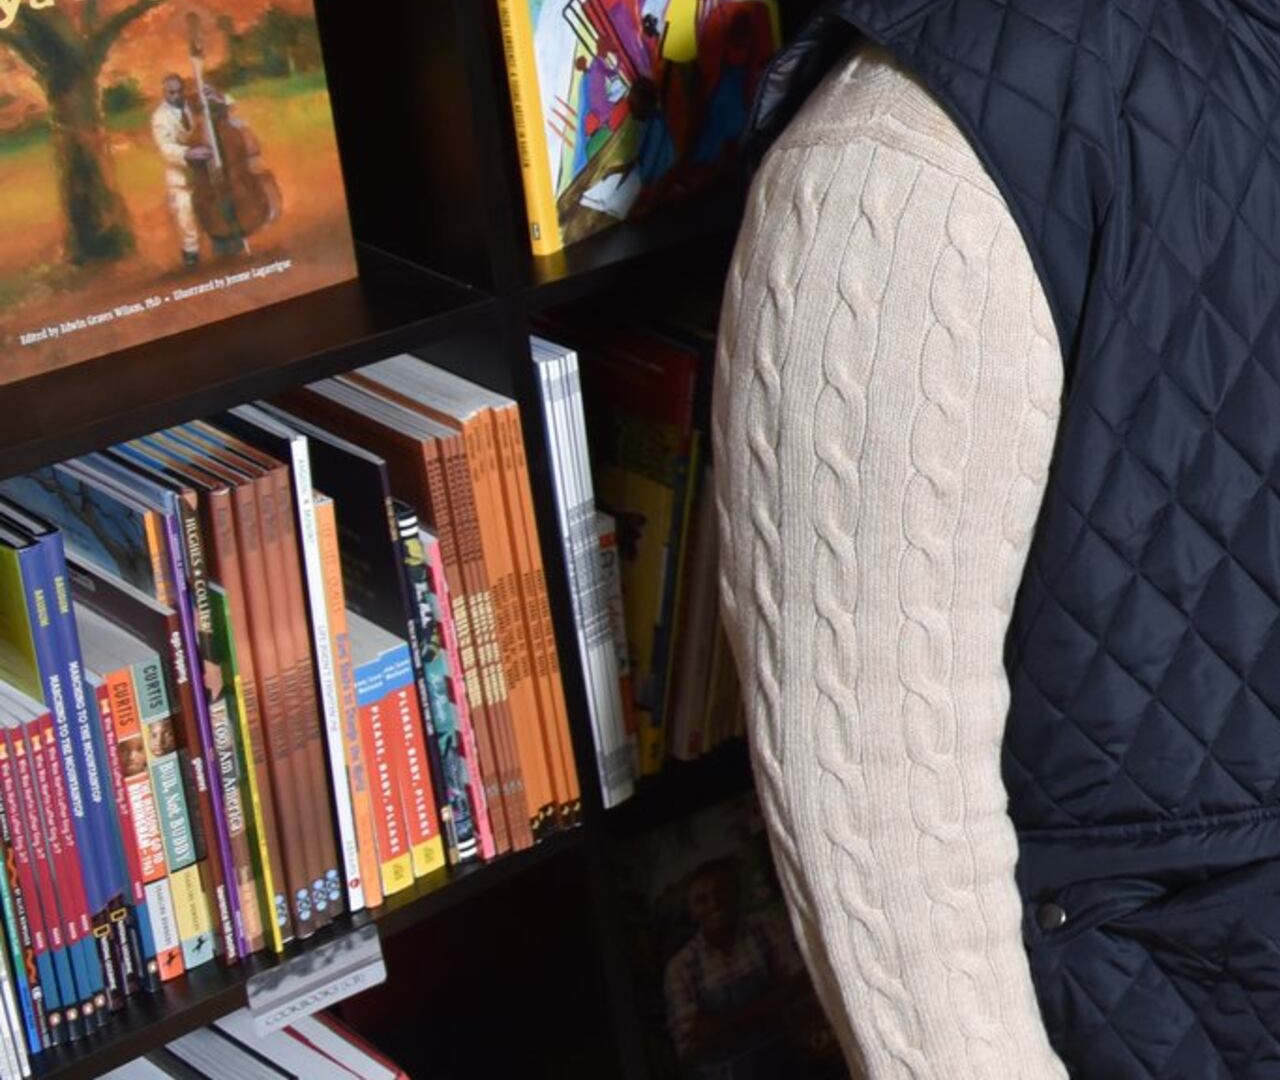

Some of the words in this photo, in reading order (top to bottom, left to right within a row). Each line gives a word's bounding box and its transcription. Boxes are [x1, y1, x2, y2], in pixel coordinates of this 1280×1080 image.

[112, 681, 135, 729] CURTIS
[142, 664, 164, 710] CURTIS
[370, 705, 385, 762] PLEASE,
[378, 763, 391, 803] BABY,
[385, 804, 400, 855] PLEASE
